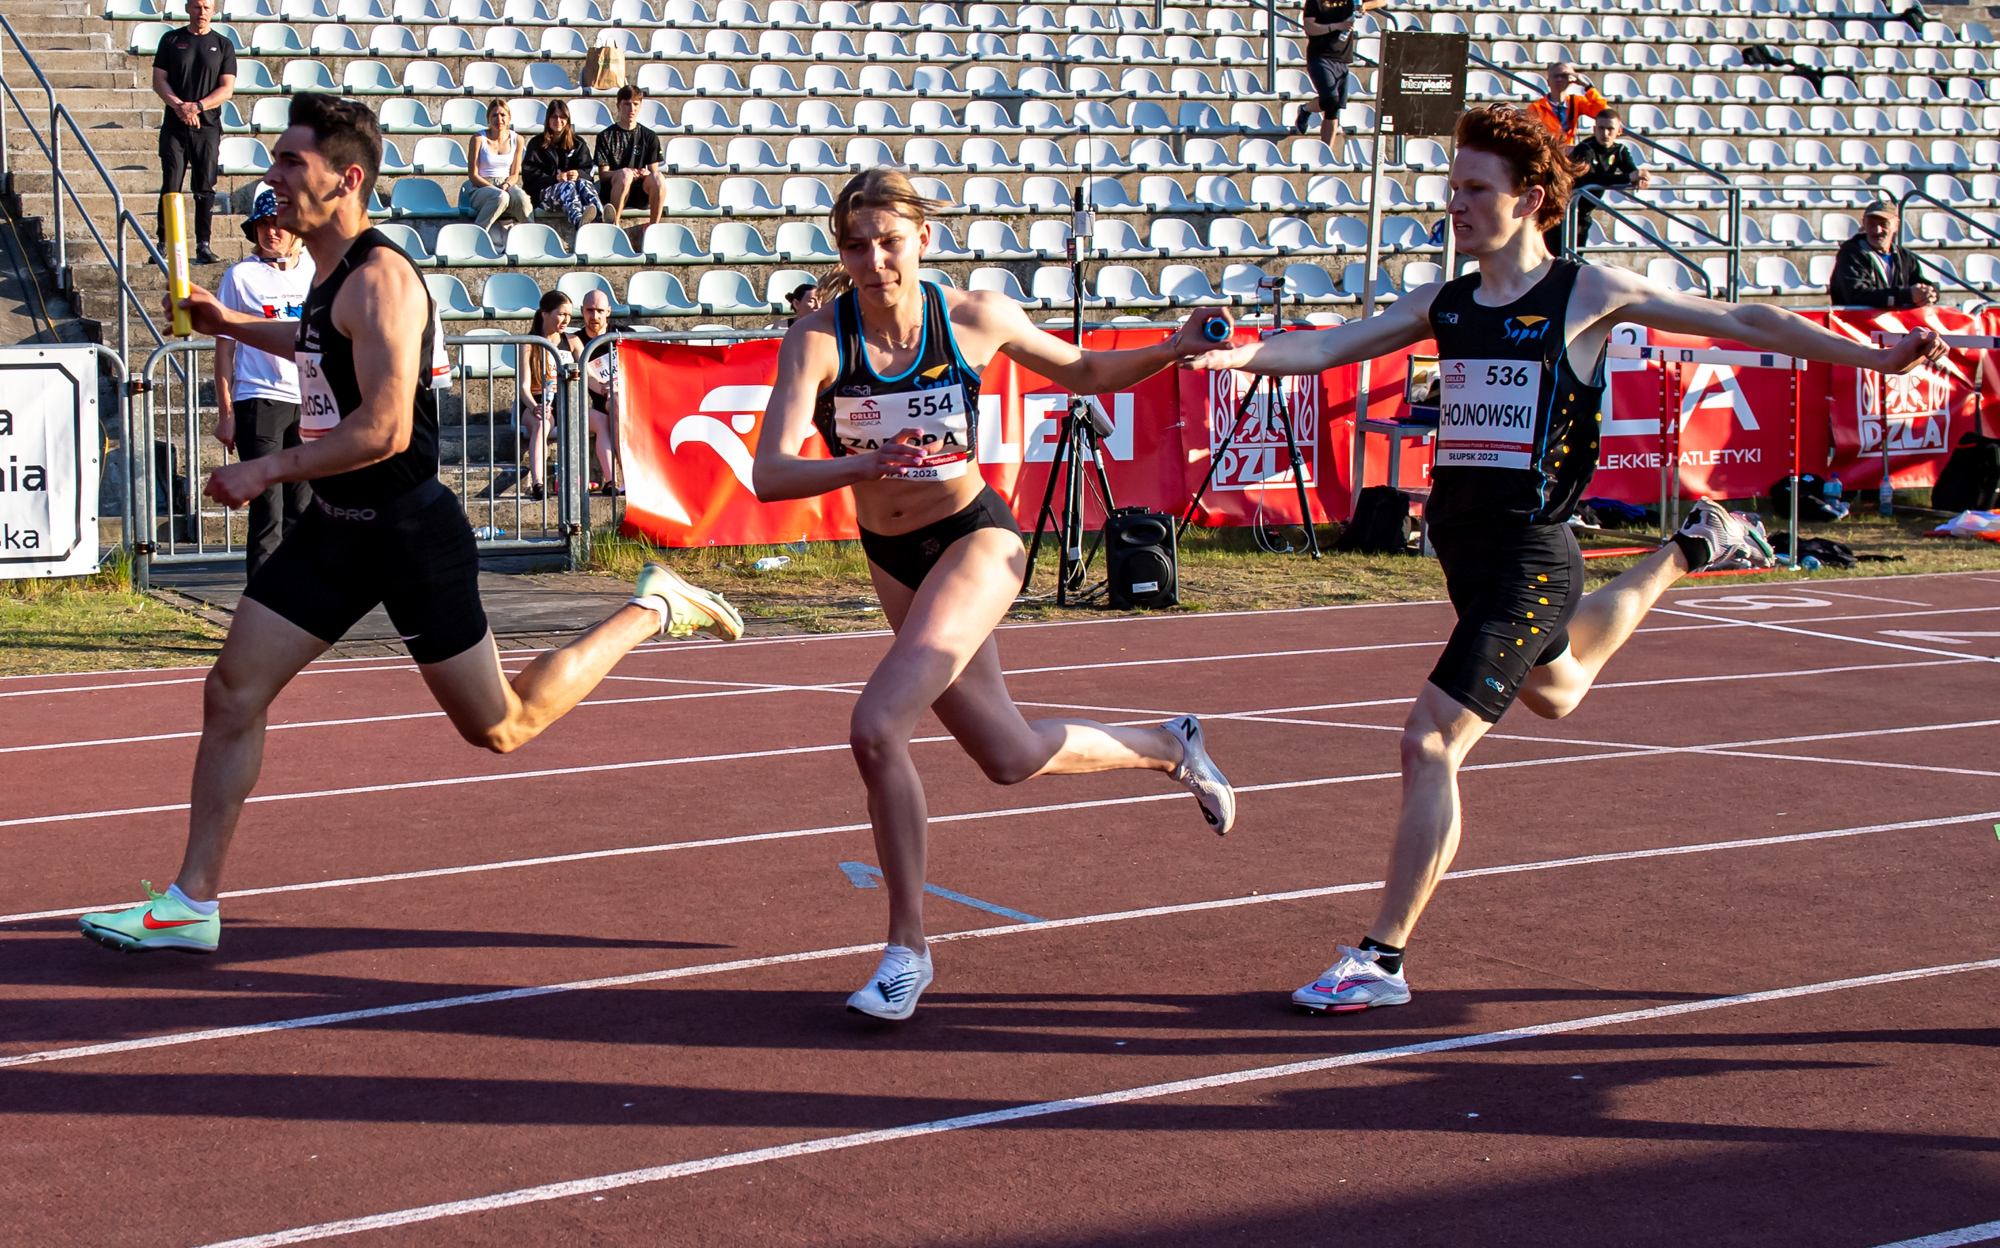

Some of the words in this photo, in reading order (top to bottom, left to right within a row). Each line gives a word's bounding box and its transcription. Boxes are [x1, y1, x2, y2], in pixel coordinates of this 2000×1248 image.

[1502, 318, 1550, 346] Sopot
[1485, 366, 1528, 386] 536
[908, 393, 953, 418] 554
[1862, 416, 1942, 451] PZLA
[1216, 447, 1312, 484] PZLA
[1477, 453, 1499, 461] 2023
[1678, 448, 1761, 466] ATLETYKI
[912, 470, 938, 478] 2023
[0, 523, 40, 549] ka
